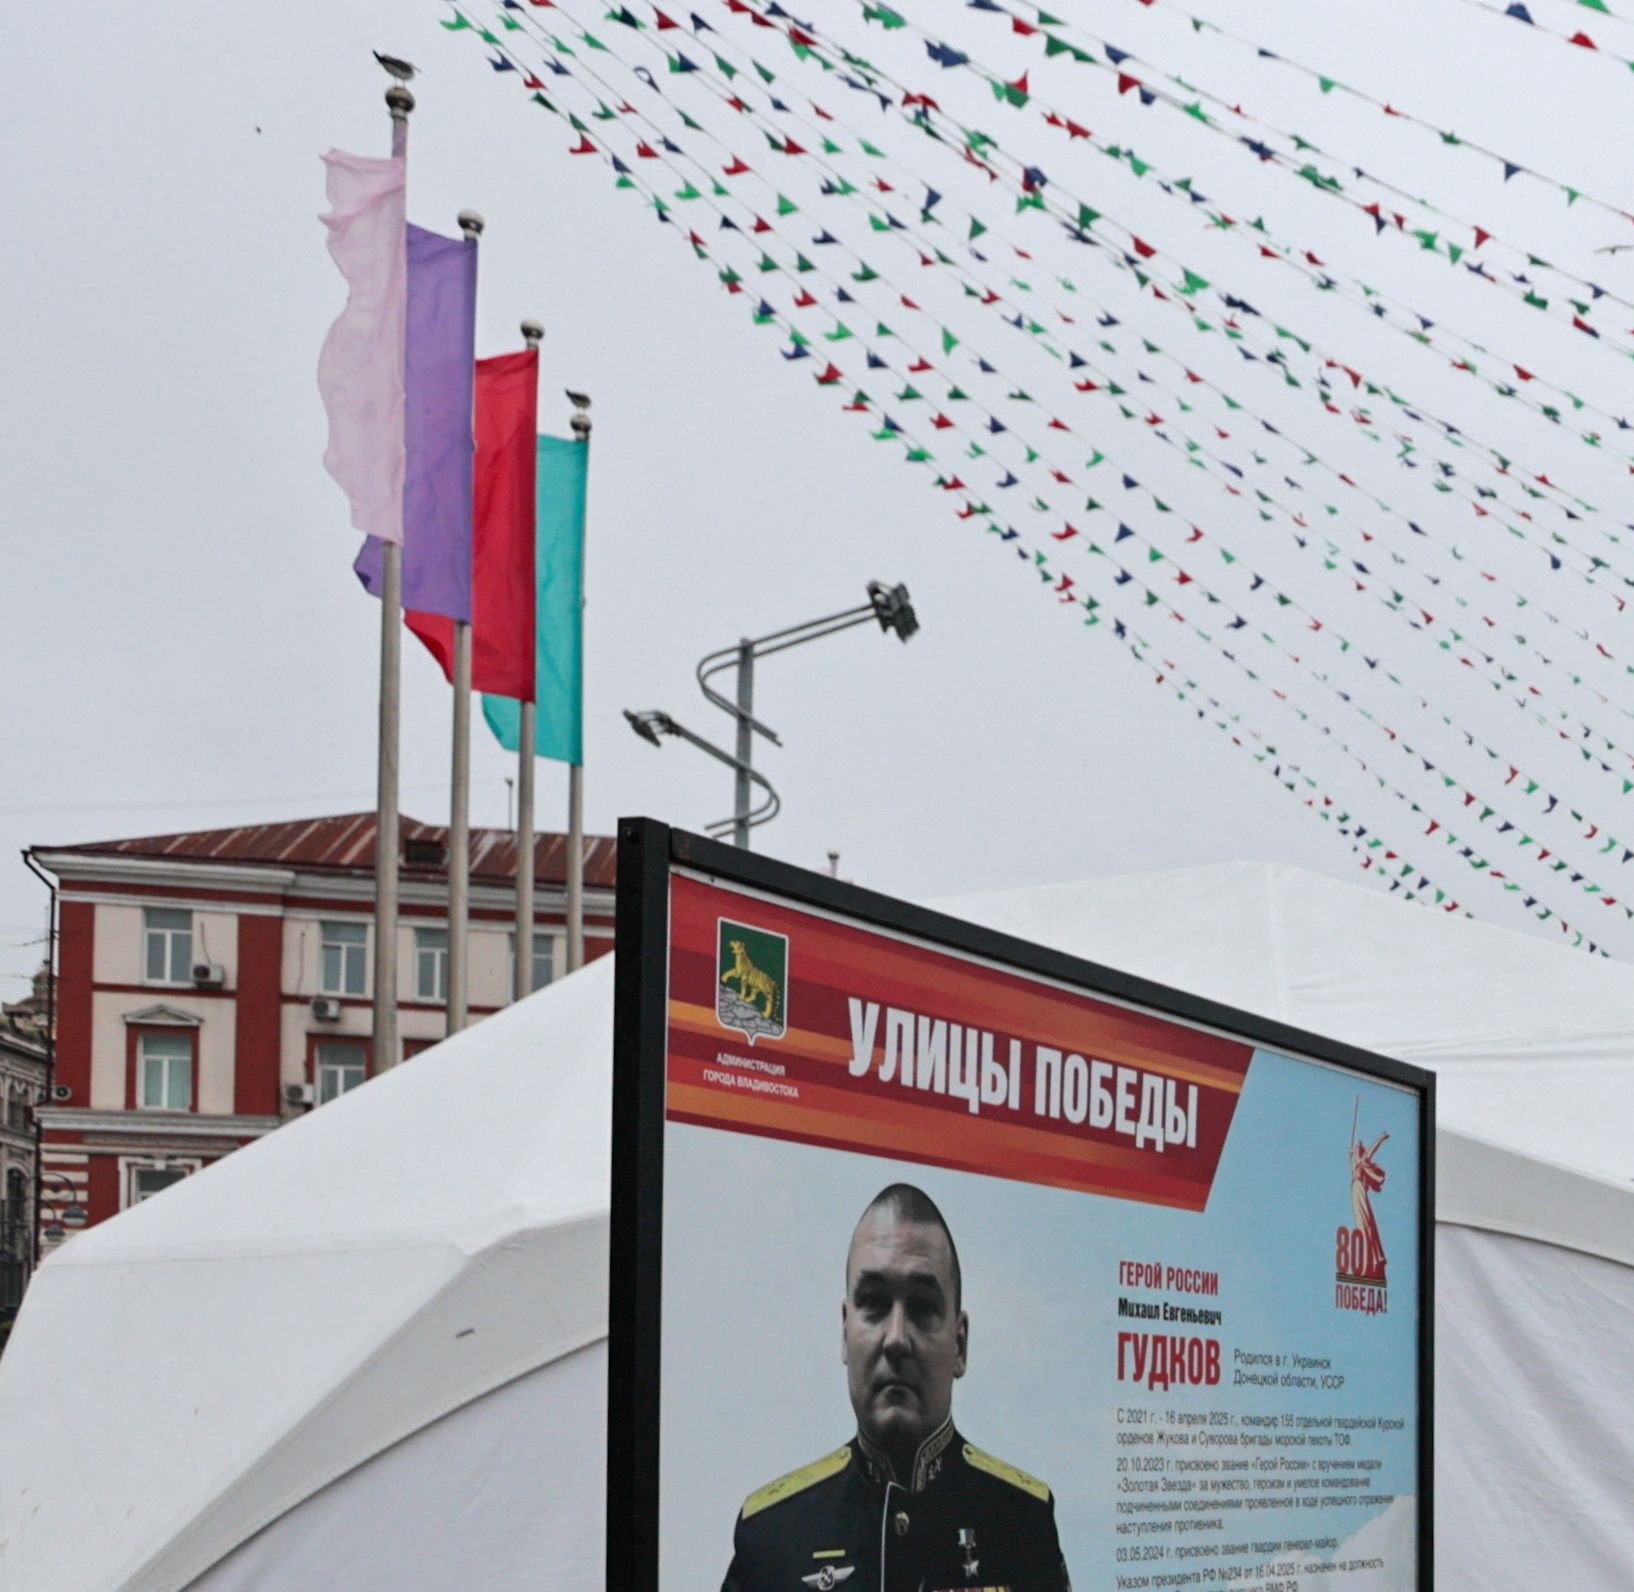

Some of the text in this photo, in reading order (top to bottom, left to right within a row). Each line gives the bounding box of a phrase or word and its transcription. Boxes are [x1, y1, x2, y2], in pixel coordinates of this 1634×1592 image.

[716, 1052, 786, 1076] АДМИНИСТРАЦИЯ
[847, 997, 1198, 1153] УЛИЦЫ ПОБЕДЫ
[703, 1069, 799, 1098] ГОРОДА ВЛАДИВОСТОКА
[1336, 1226, 1365, 1274] 80
[1119, 1260, 1218, 1295] ГЕРОЙ РОССИИ
[1118, 1298, 1222, 1325] Михаил Евгеньевич
[1335, 1284, 1388, 1316] ПОБЕДА!
[1117, 1332, 1221, 1392] ГУДКОВ
[1234, 1349, 1331, 1371] Родился в г. Украинск
[1233, 1370, 1345, 1390] Донецкой области, УССР
[1117, 1408, 1124, 1424] С
[1127, 1409, 1148, 1424] 2021
[1166, 1410, 1176, 1425] 16
[1177, 1412, 1207, 1428] апреля
[1209, 1411, 1229, 1426] 2025
[1241, 1415, 1278, 1431] командир
[1281, 1413, 1294, 1427] 155
[1116, 1431, 1154, 1447] орденов
[1156, 1430, 1189, 1448] Жукова
[1191, 1434, 1197, 1445] и
[1198, 1430, 1238, 1448] Суворова
[1116, 1457, 1165, 1473] 20.10.2023
[1175, 1459, 1219, 1474] присвоено
[1221, 1460, 1249, 1472] звание
[1117, 1477, 1159, 1493] «Золотая
[1161, 1477, 1196, 1493] Звезда»
[1199, 1480, 1208, 1491] за
[1116, 1500, 1182, 1515] подчиненными
[1116, 1518, 1224, 1537] наступления противника.
[1116, 1545, 1164, 1562] 03.05.2024
[1175, 1544, 1219, 1560] присвоено
[1221, 1543, 1249, 1556] звание
[1116, 1574, 1149, 1590] Указом
[1151, 1572, 1201, 1588] президента
[1202, 1568, 1216, 1583] РФ
[1218, 1566, 1242, 1581] №234
[1244, 1569, 1253, 1579] от
[1255, 1561, 1296, 1579] 16.04.2025
